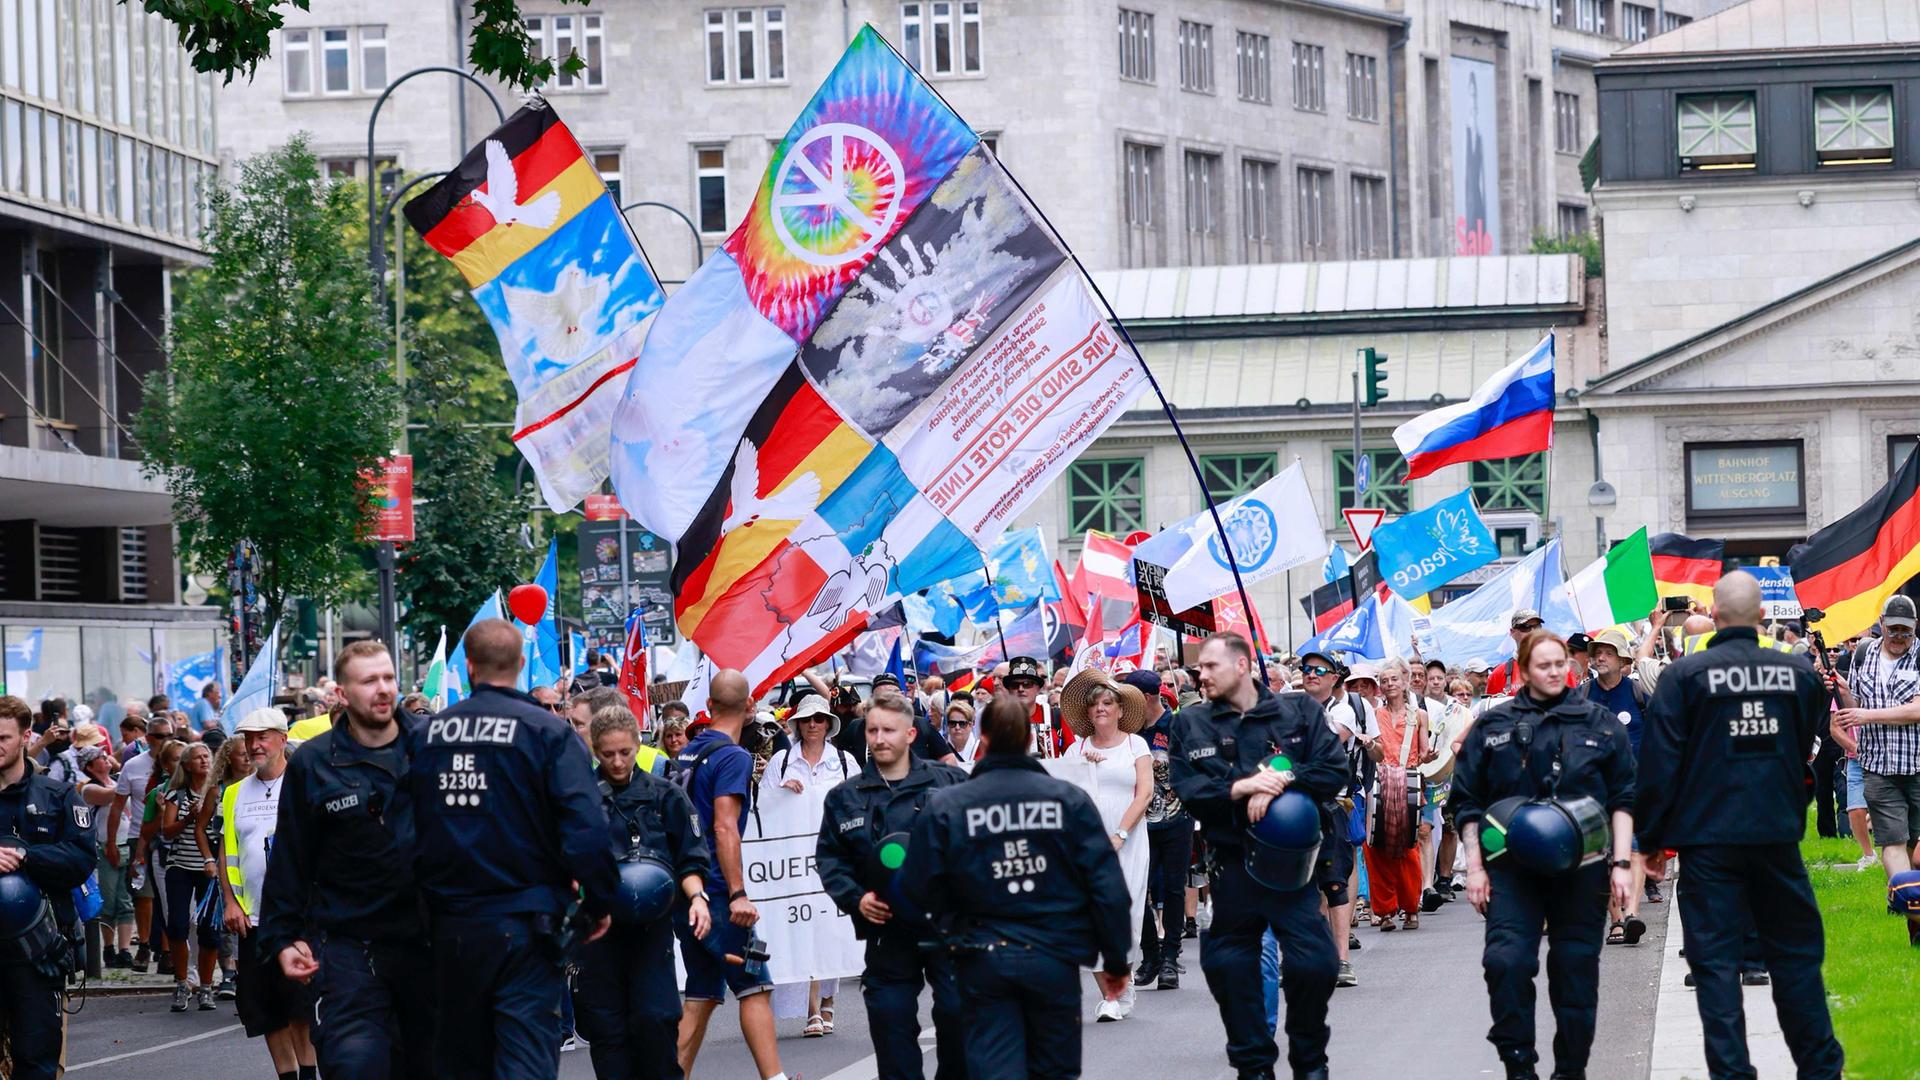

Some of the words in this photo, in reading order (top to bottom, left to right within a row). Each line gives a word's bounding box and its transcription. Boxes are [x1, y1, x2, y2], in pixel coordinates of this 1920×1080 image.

[1455, 216, 1493, 256] Sale
[1718, 457, 1771, 469] BAHNHOF
[1694, 471, 1797, 485] WITTENBERGPLATZ
[1719, 487, 1771, 499] AUSGANG
[1138, 560, 1166, 577] WENN
[1707, 666, 1796, 694] POLIZEI
[1741, 701, 1764, 719] BE
[427, 716, 518, 744] POLIZEI
[1729, 718, 1780, 737] 32318
[452, 754, 475, 772] BE
[1188, 747, 1216, 761] POLIZEI
[438, 773, 488, 790] 32301
[325, 794, 359, 813] POLIZEI
[840, 817, 865, 833] POLIZEI
[966, 801, 1063, 837] POLIZEI
[1003, 839, 1029, 859] BE
[748, 855, 818, 884] QUER
[991, 855, 1047, 879] 32310
[788, 904, 812, 924] 30
